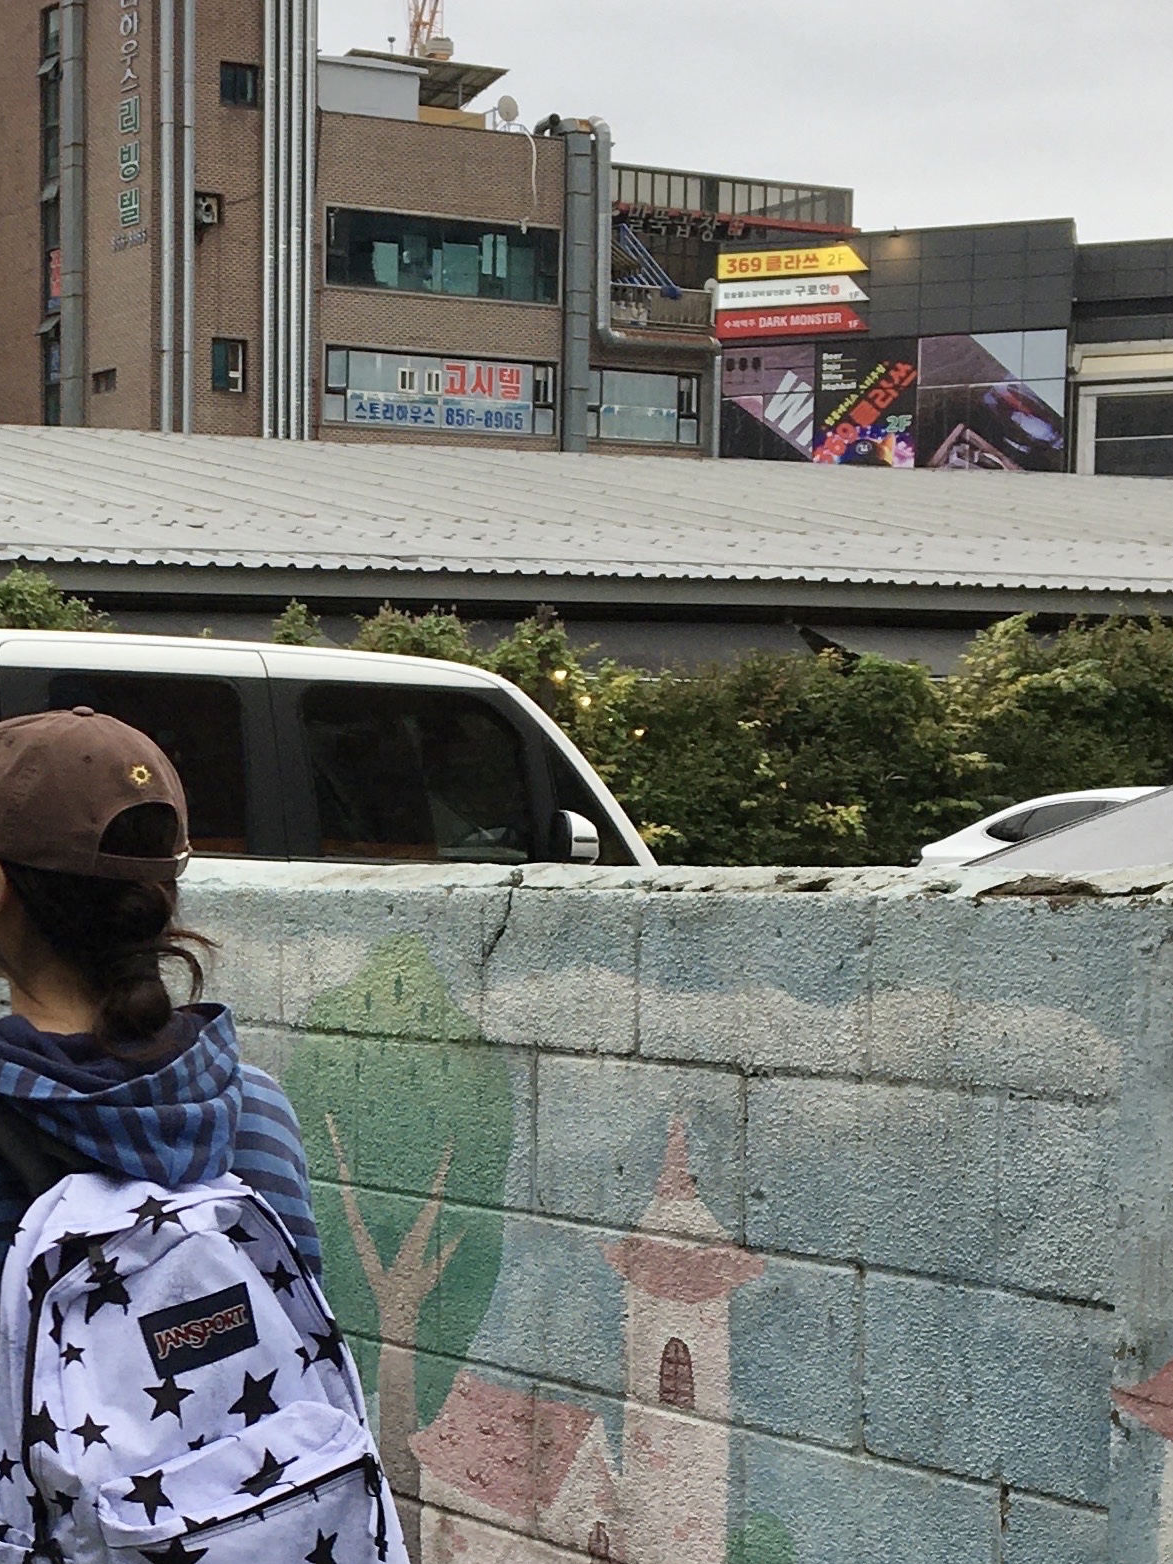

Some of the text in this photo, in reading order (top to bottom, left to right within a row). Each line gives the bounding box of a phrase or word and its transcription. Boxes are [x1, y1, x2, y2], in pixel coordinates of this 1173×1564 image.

[726, 252, 846, 274] 369 클라쓰 2F
[794, 283, 830, 297] 구로안
[848, 290, 860, 299] 1F
[758, 315, 788, 328] DARK
[790, 312, 842, 326] MONSTER
[848, 319, 860, 329] 1F
[355, 401, 524, 430] 스토리하우스 856-8965
[884, 414, 913, 433] 2F
[153, 1303, 249, 1361] JANSPORT
